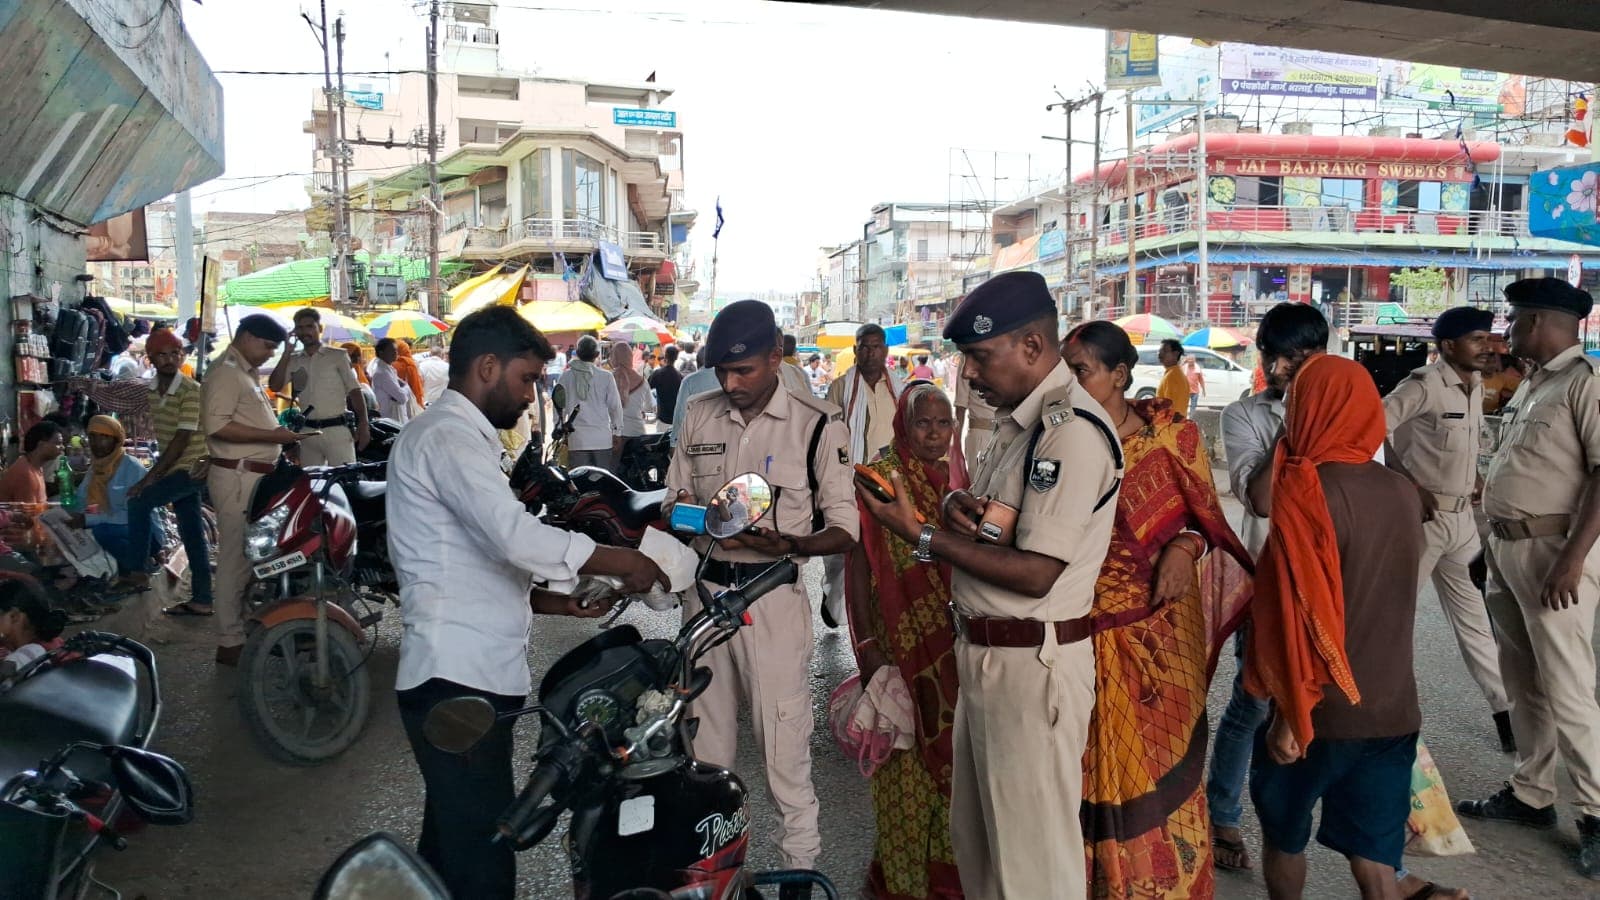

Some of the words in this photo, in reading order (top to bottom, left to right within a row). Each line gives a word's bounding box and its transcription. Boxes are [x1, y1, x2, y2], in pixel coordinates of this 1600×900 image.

[1236, 159, 1267, 173] JAI
[1280, 160, 1367, 176] BAJRANG
[1377, 163, 1447, 179] SWEETS
